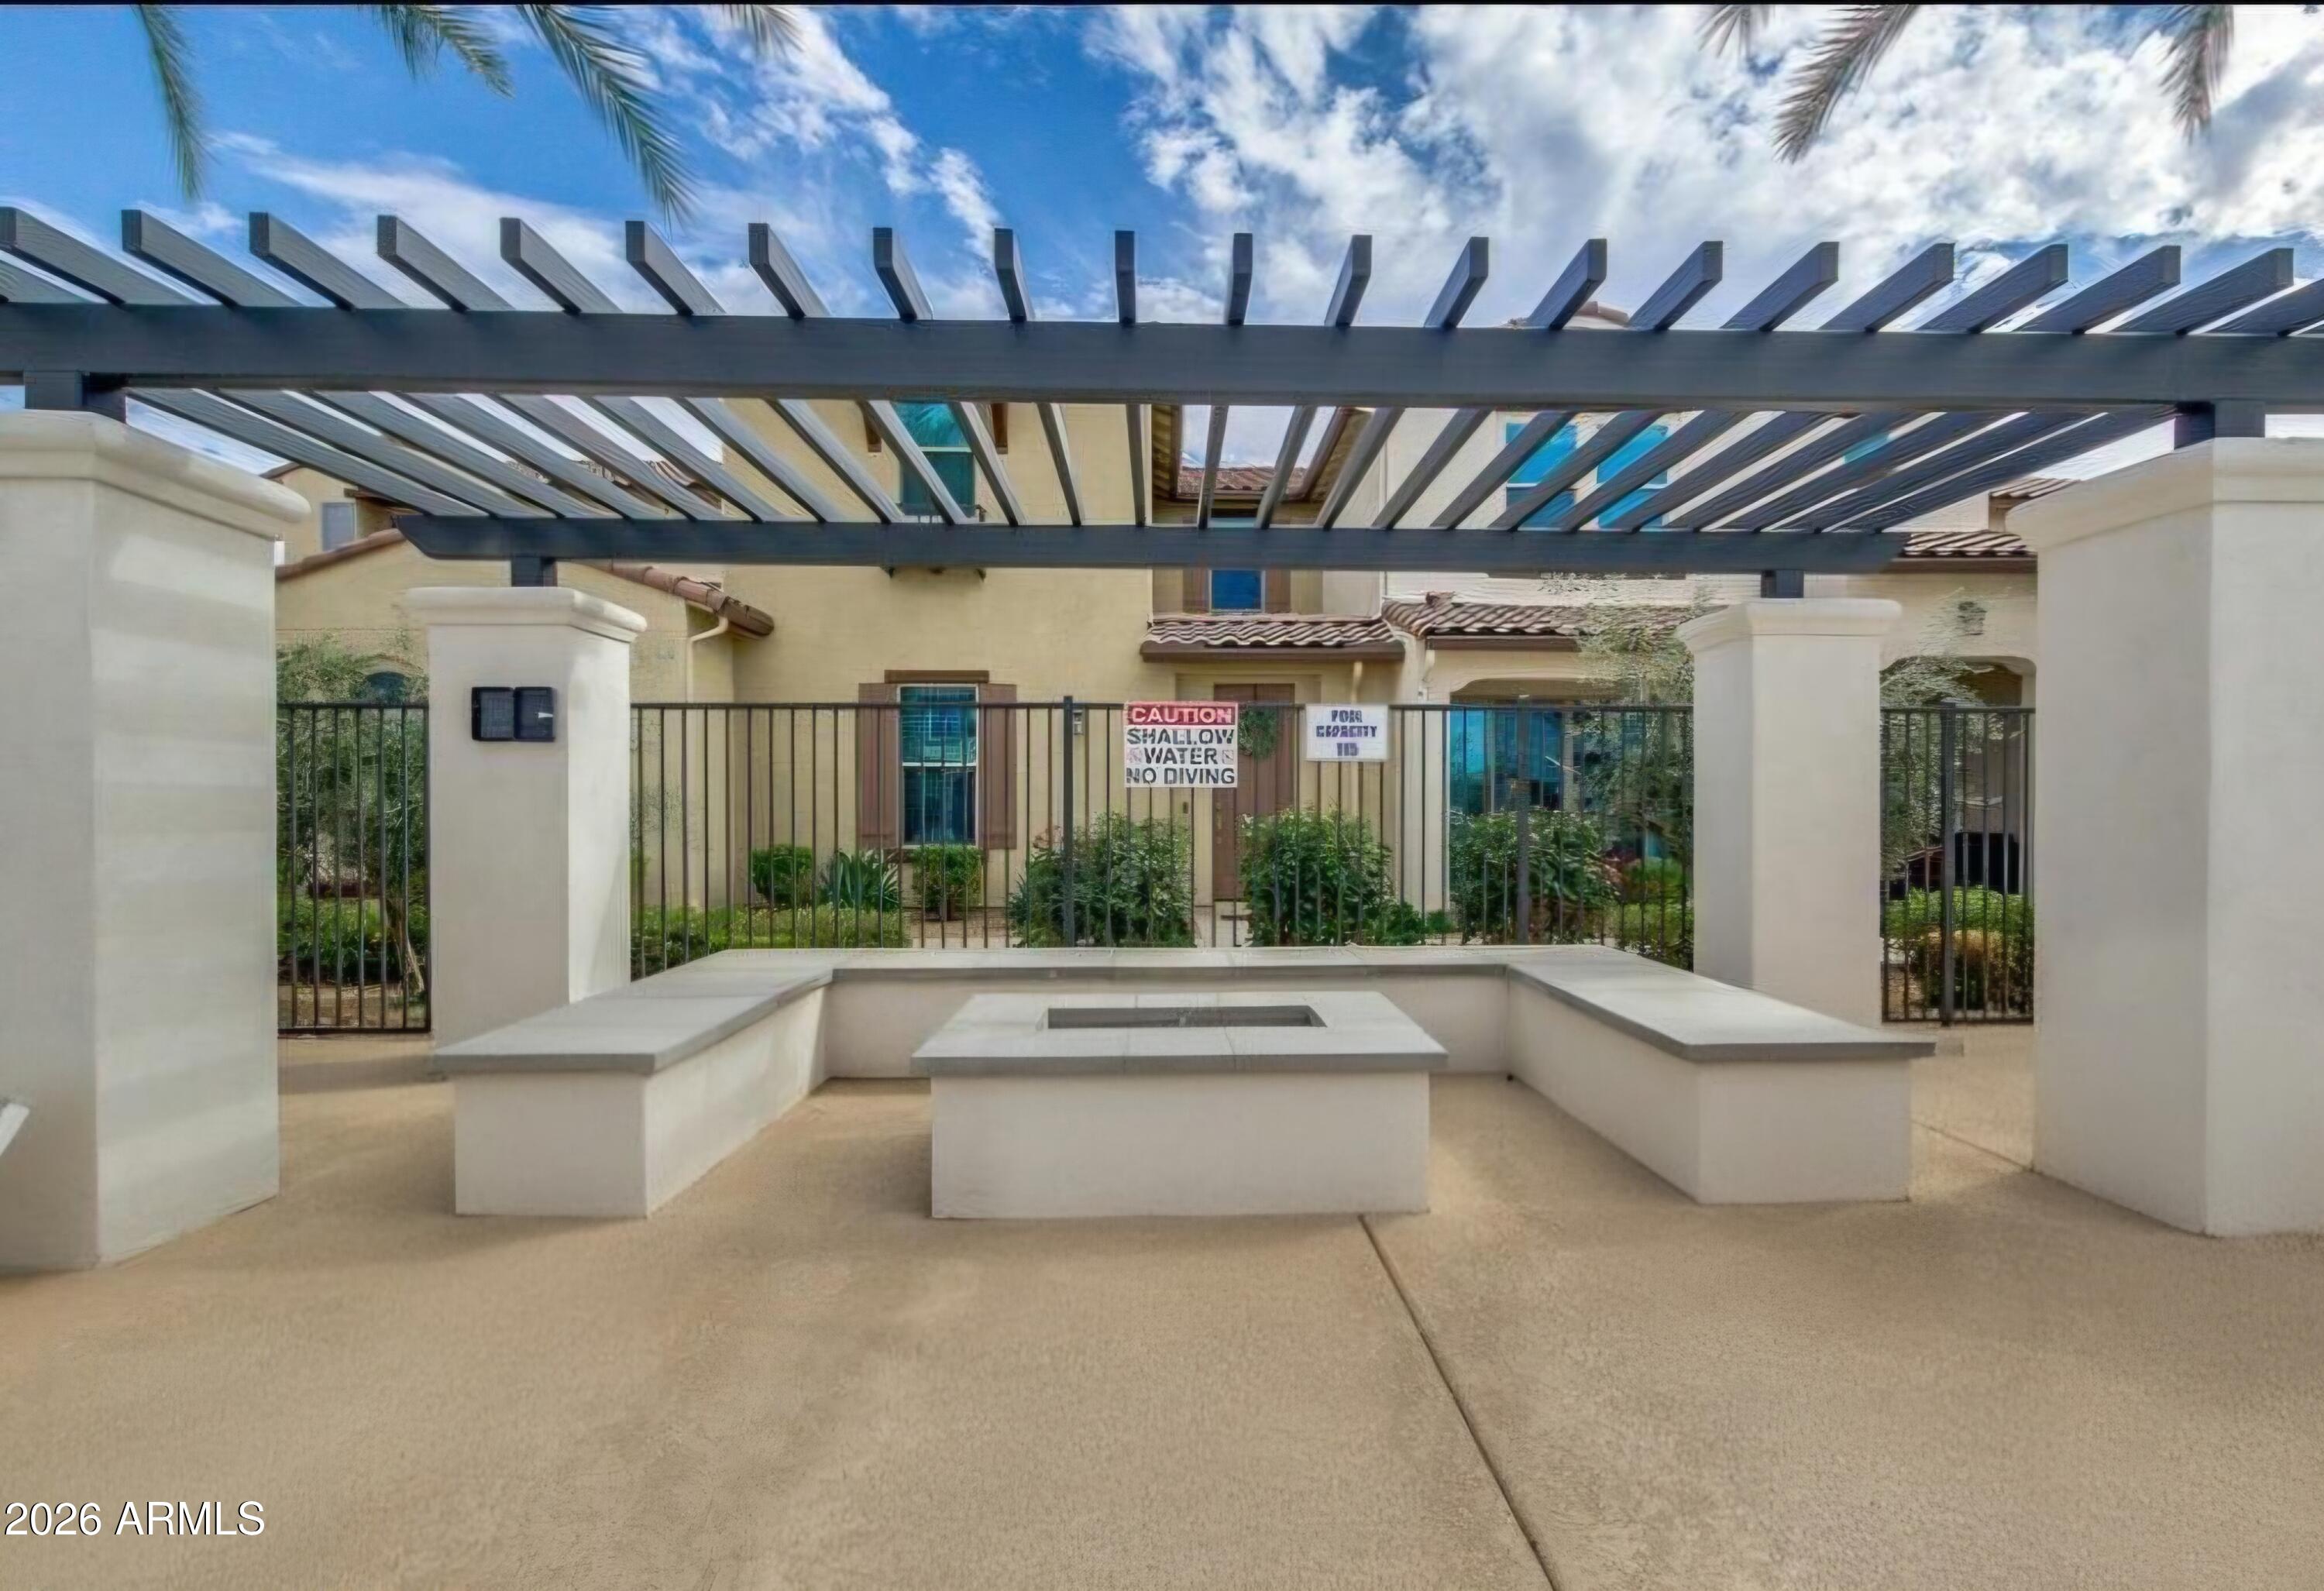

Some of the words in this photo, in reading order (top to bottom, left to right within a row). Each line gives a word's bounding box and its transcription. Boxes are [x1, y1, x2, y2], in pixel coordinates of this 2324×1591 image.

[1132, 707, 1232, 723] CAUTION
[1127, 728, 1234, 745] SHALLOW
[1143, 747, 1219, 765] WATER
[1126, 767, 1157, 784] NO
[1164, 768, 1235, 785] DIVING
